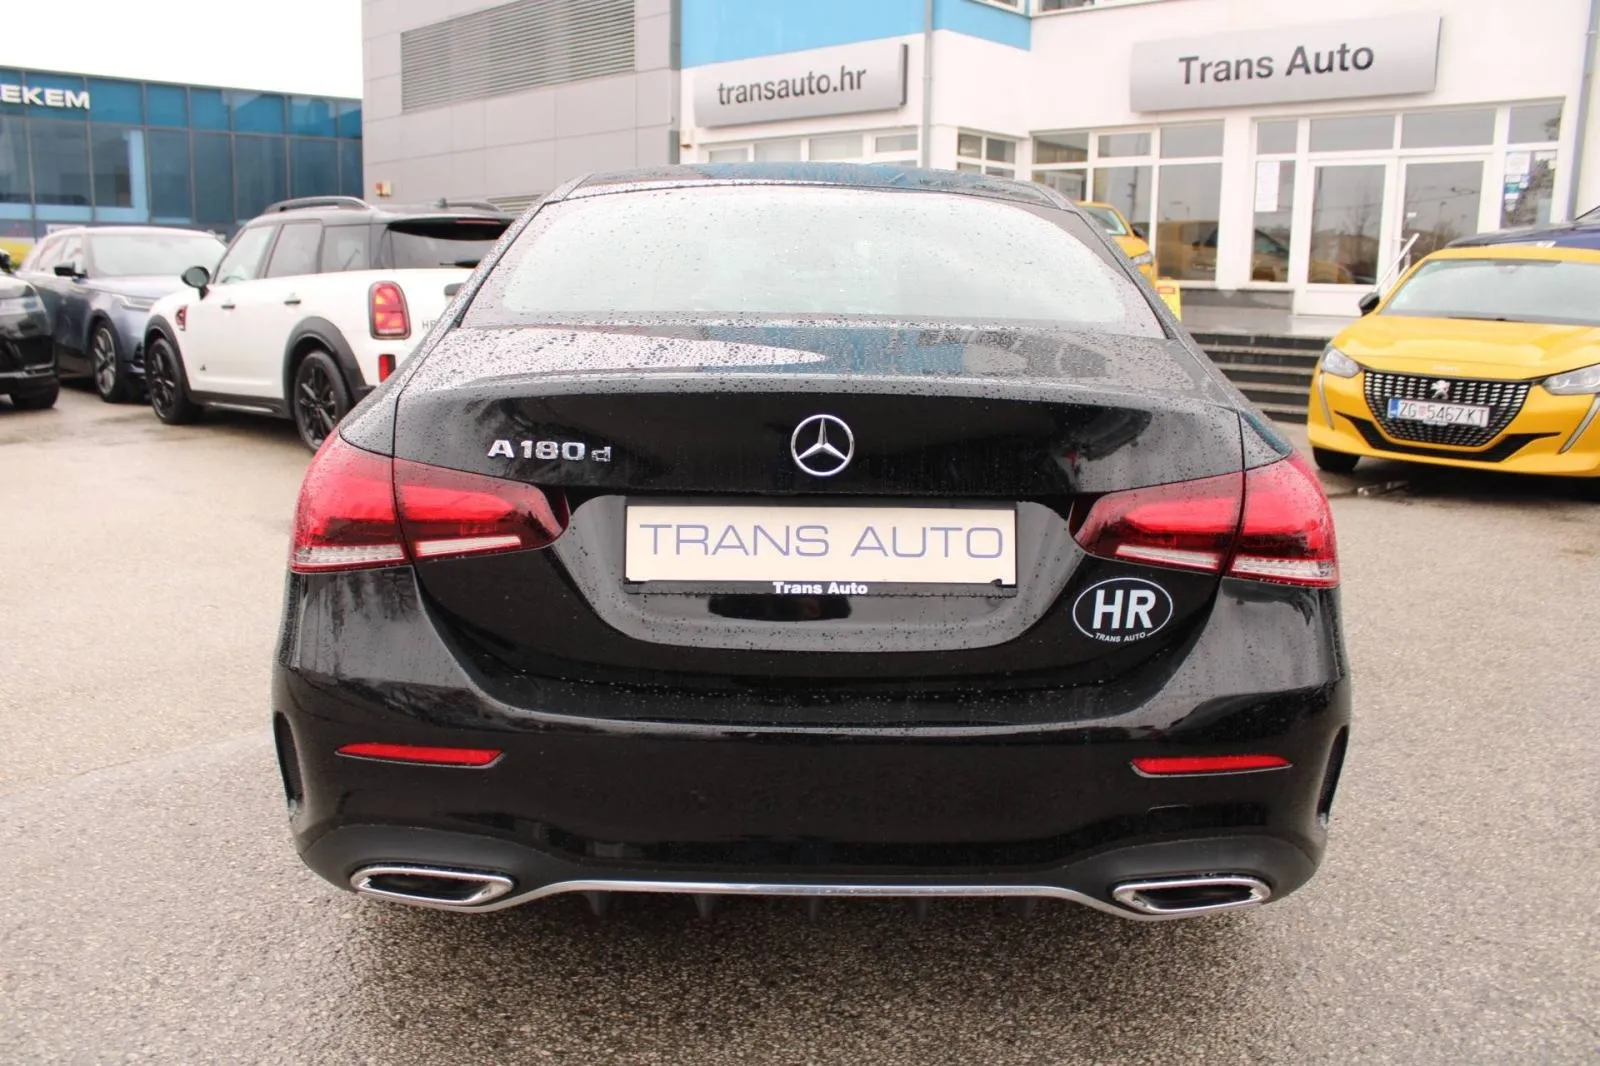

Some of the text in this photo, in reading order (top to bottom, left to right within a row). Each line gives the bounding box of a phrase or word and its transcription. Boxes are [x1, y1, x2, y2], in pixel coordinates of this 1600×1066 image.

[1178, 43, 1374, 85] Trans Auto
[0, 84, 90, 110] EKEM
[717, 65, 867, 106] transauto.hr
[1399, 402, 1417, 418] ZG
[639, 523, 1004, 559] TRANS AUTO
[772, 581, 868, 595] Trans Auto
[1092, 589, 1156, 629] HR
[1095, 632, 1146, 642] TRANS AUTO
